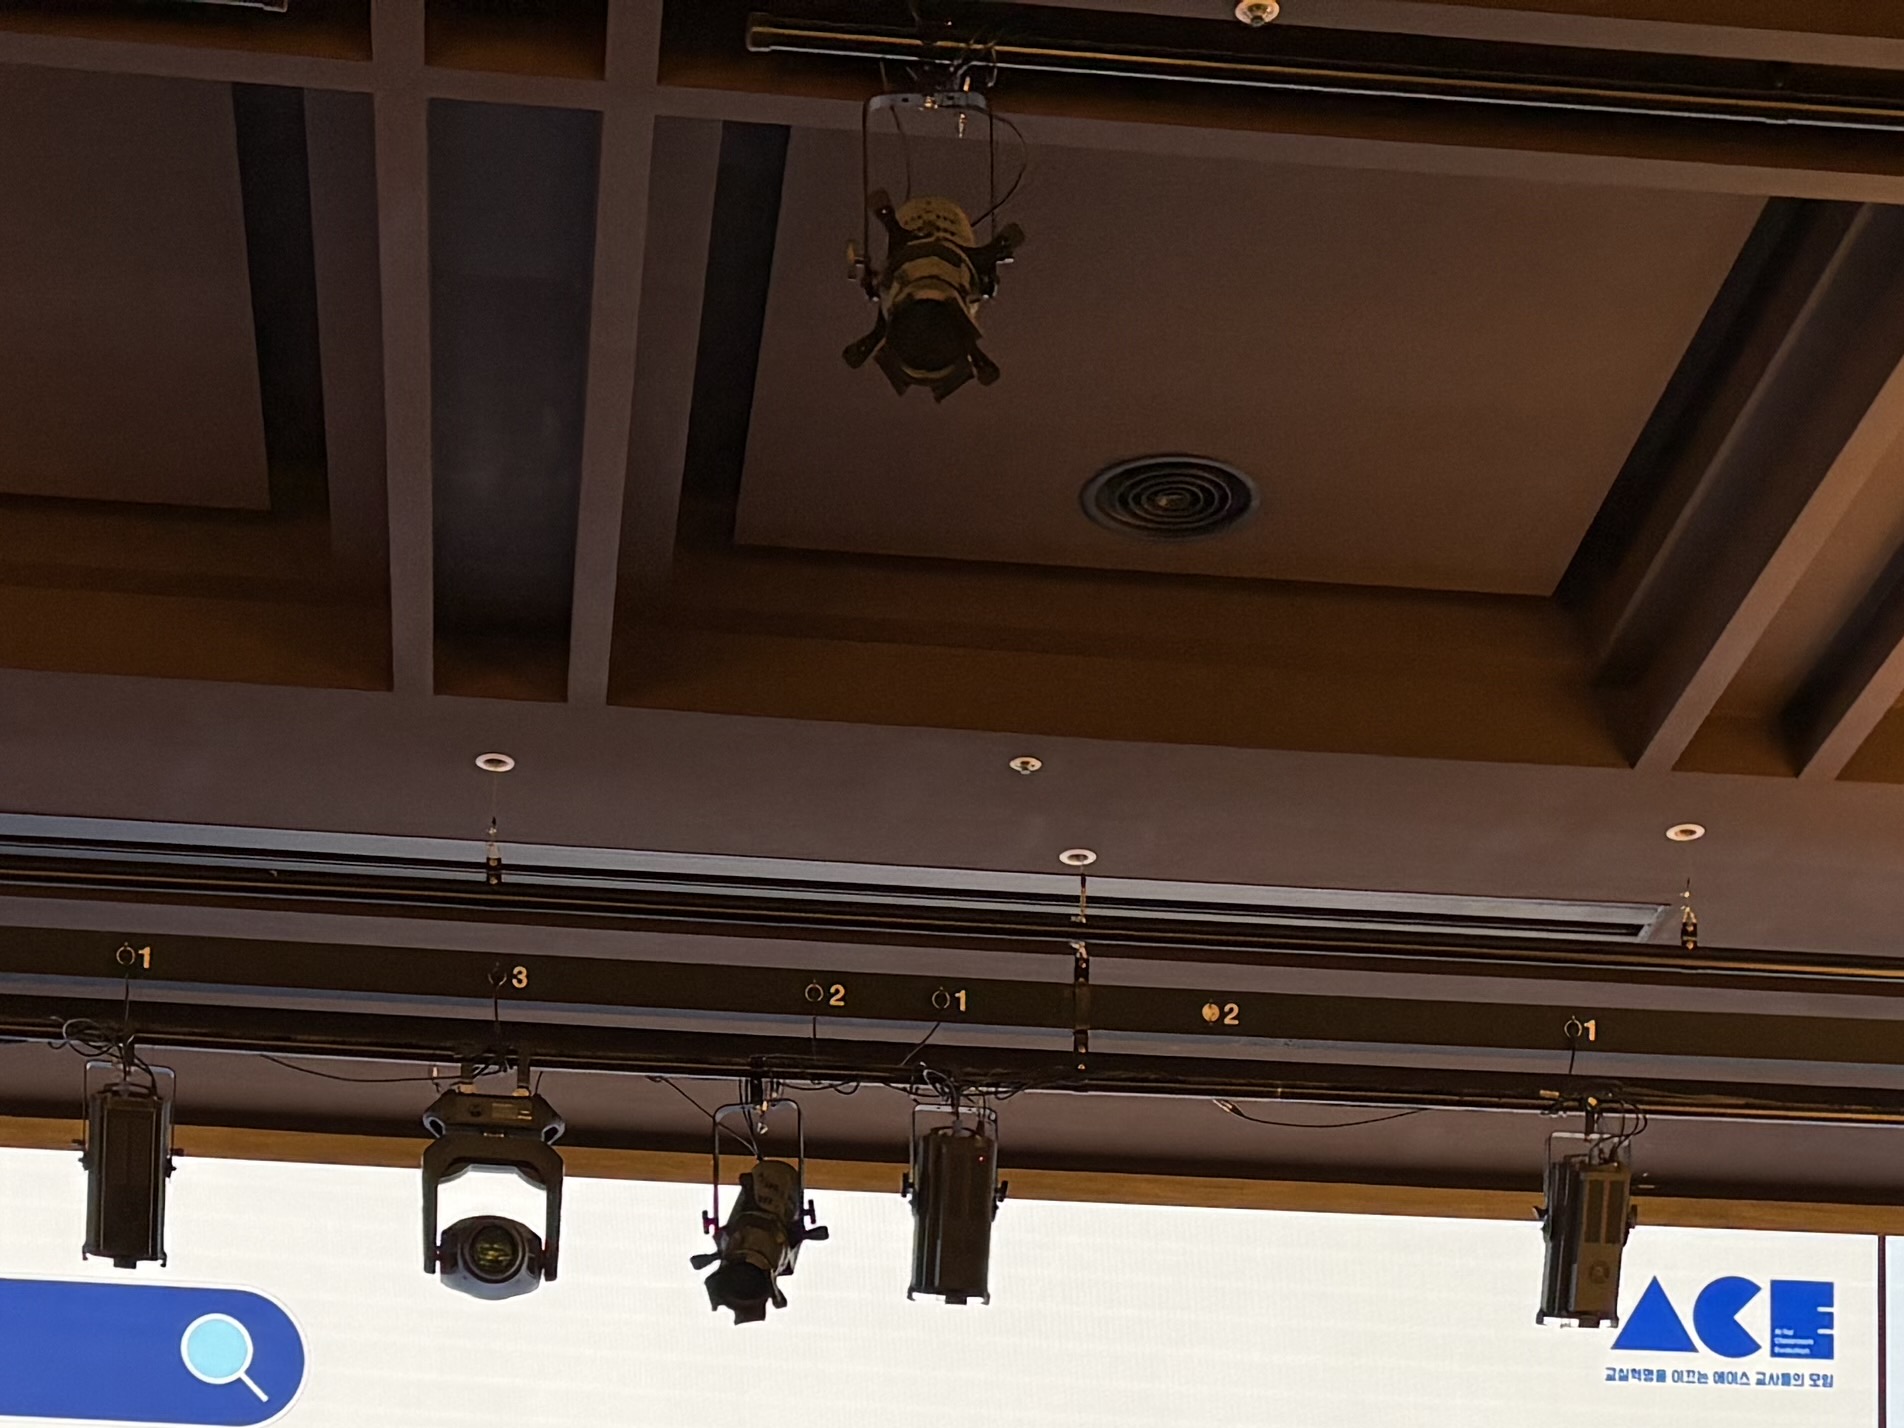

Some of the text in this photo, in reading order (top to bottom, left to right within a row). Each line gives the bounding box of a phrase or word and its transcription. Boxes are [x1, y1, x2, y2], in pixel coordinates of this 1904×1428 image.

[138, 947, 150, 968] 1
[512, 966, 527, 988] 3
[830, 984, 845, 1006] 2
[955, 990, 965, 1011] 1
[1224, 1003, 1239, 1024] 2
[1584, 1020, 1595, 1040] 1
[1611, 1275, 1834, 1359] ACE
